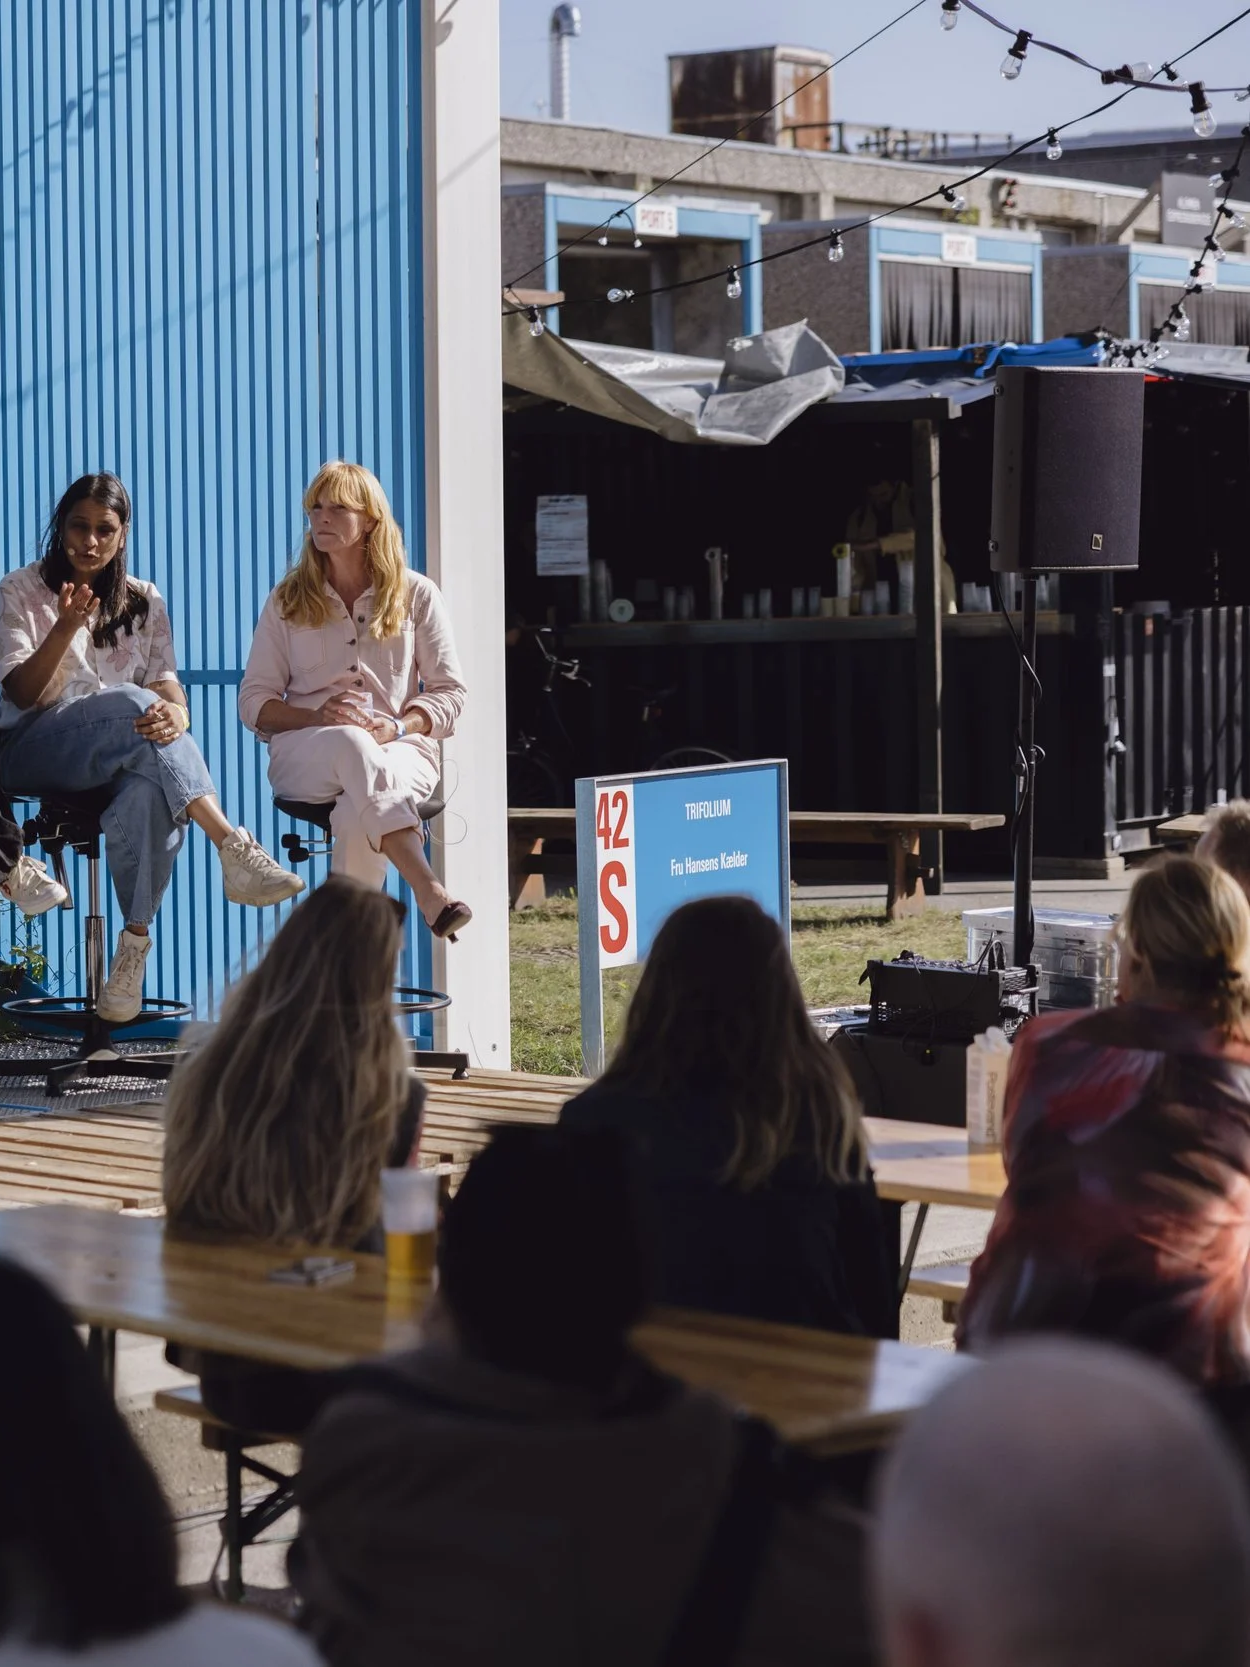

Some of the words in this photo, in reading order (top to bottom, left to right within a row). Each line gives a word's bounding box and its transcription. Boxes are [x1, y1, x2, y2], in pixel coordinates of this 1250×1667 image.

[597, 790, 630, 850] 42
[685, 799, 731, 820] TRIFOLIUM
[671, 859, 684, 876] Fru
[685, 857, 719, 874] Hansens
[720, 851, 749, 870] Kælder
[600, 860, 628, 954] S
